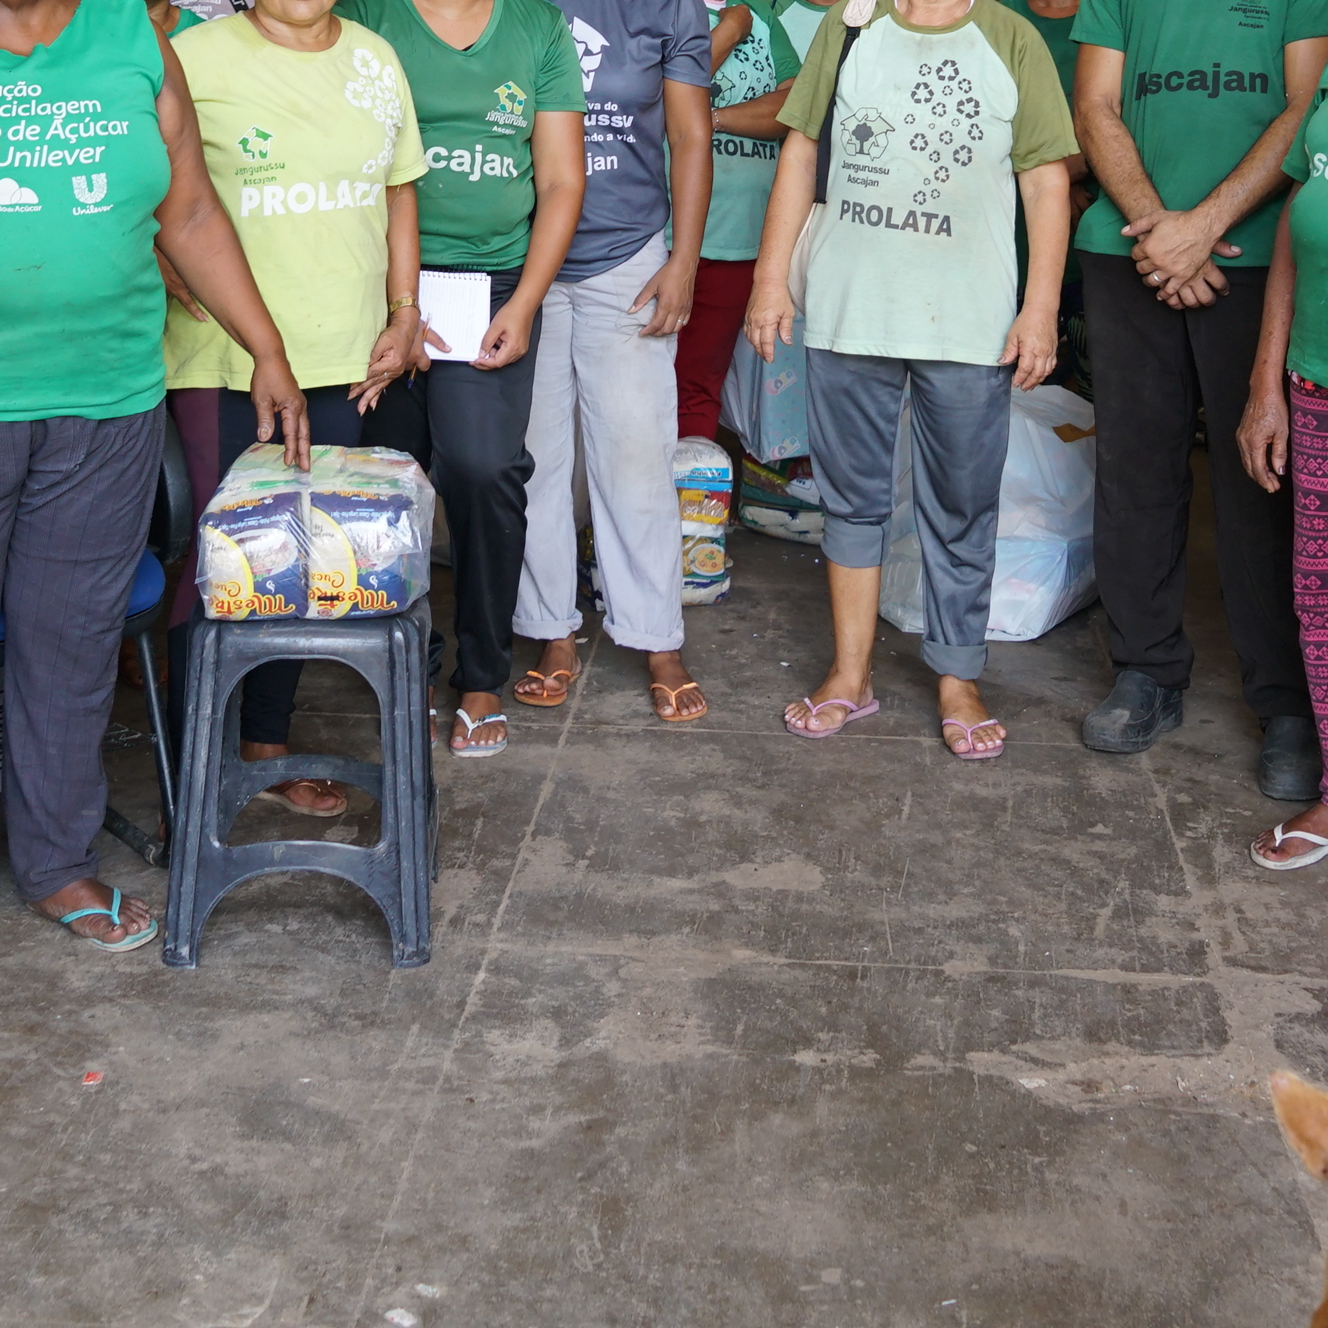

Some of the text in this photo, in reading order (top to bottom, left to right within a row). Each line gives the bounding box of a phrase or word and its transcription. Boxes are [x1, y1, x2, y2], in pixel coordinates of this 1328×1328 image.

[603, 101, 618, 111] do
[7, 120, 41, 141] de
[45, 117, 129, 144] Açúcar
[712, 138, 777, 161] ROLATA
[425, 144, 519, 182] cajan
[841, 160, 890, 175] Jangurussu
[846, 174, 880, 188] Ascajan
[839, 199, 953, 237] PROLATA
